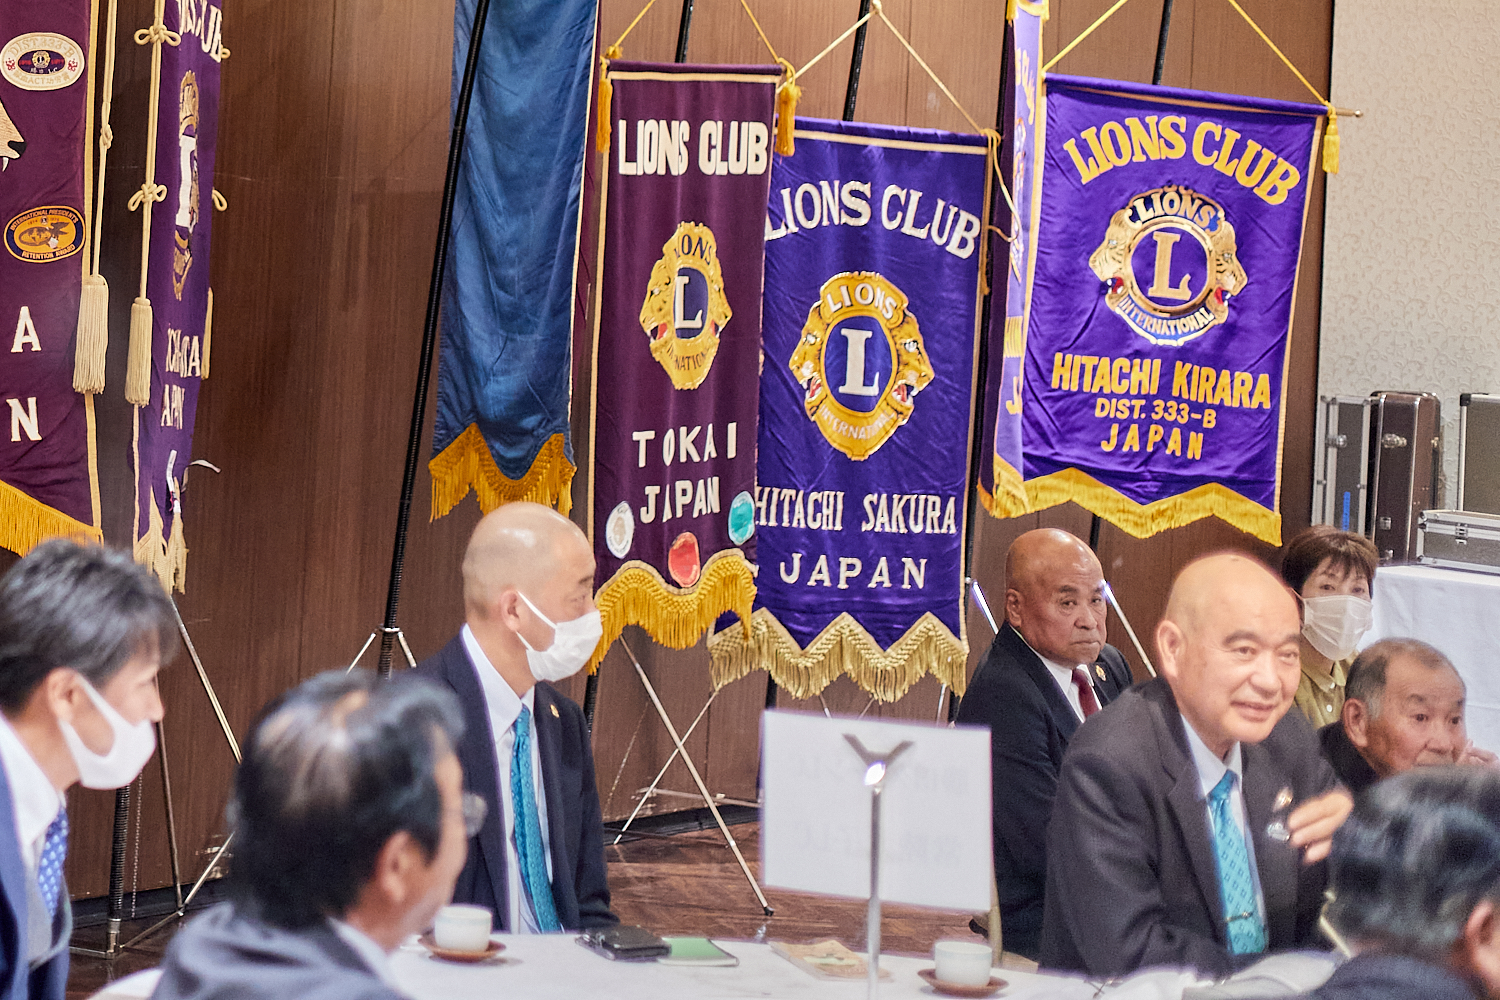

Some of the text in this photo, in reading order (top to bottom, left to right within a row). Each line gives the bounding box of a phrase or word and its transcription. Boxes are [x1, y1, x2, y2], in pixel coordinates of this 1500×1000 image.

[618, 119, 769, 176] LIONS CLUB
[1063, 115, 1301, 205] LIONS CLUB
[764, 179, 981, 260] LIONS CLUB
[1133, 191, 1216, 229] LIONS
[673, 233, 712, 266] ONS
[1147, 230, 1192, 301] L
[674, 275, 703, 329] L
[826, 282, 897, 320] LIONS
[1117, 297, 1216, 336] INTERNATIONAL
[838, 327, 880, 397] L
[1051, 352, 1271, 410] HITACHI KIRARA
[819, 402, 896, 440] INTERNATIONAL
[1094, 397, 1217, 429] DIST. 333-B
[632, 421, 737, 468] TOKAI
[1100, 423, 1204, 460] JAPAN
[640, 476, 720, 524] JAPAN
[755, 486, 957, 534] HITACHI SAKURA
[779, 553, 928, 590] JAPAN
